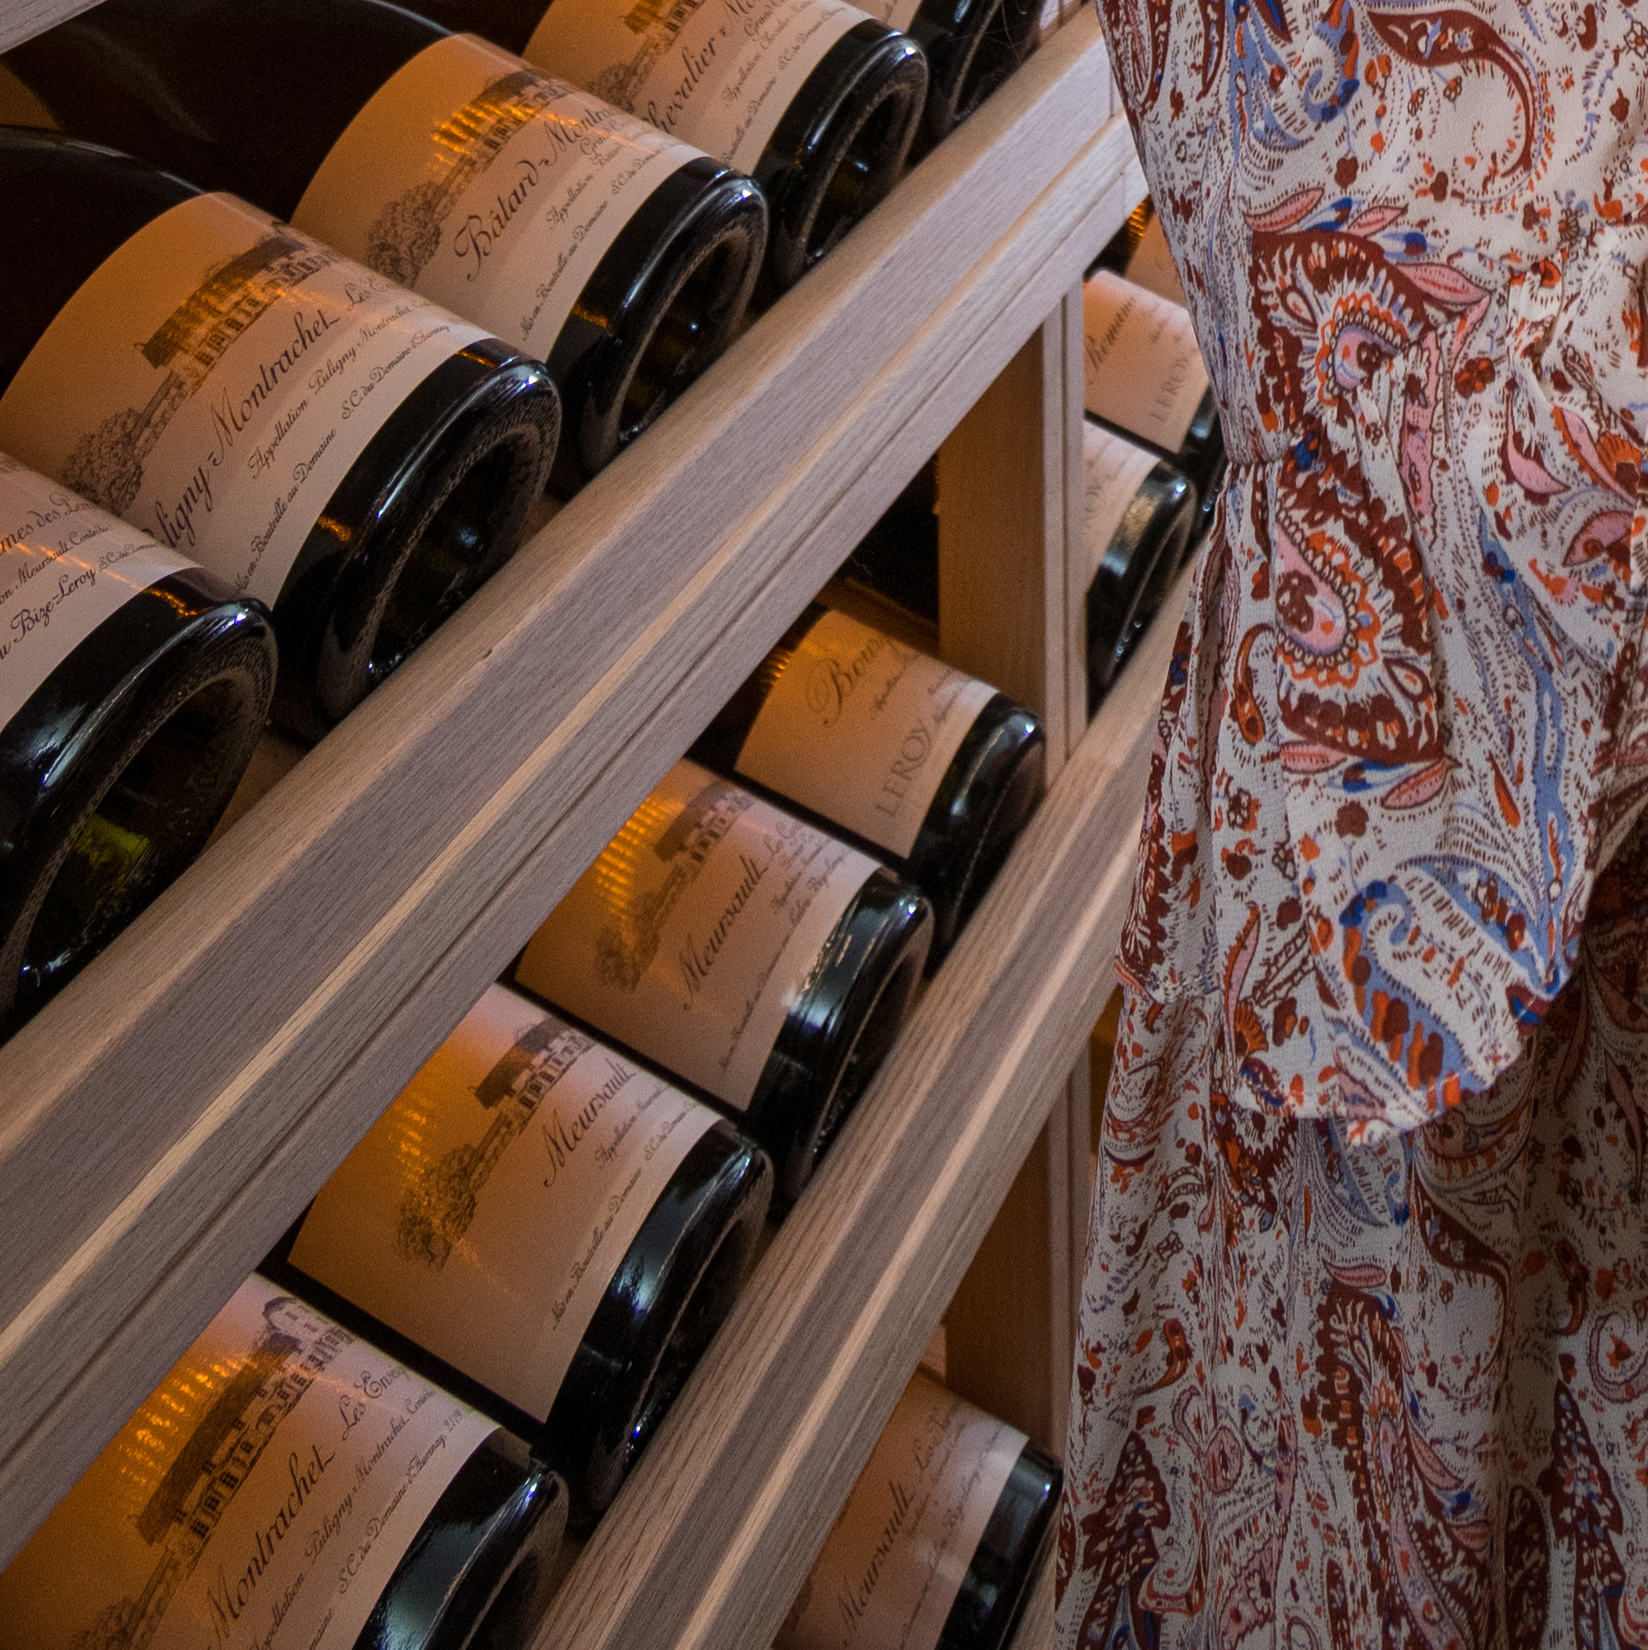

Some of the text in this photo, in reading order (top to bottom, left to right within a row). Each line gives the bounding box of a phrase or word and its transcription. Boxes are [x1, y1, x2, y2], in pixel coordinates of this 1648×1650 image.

[545, 173, 594, 231] Appellation
[535, 251, 569, 301] Bouteille
[571, 199, 609, 243] Domaine
[1151, 353, 1190, 423] LEROY
[248, 398, 309, 480] Appellation
[250, 495, 289, 561] Bouteille
[292, 427, 338, 485] Domaine
[10, 567, 96, 644] Bize-Leroy
[14, 541, 72, 590] Meursault
[875, 720, 932, 818] LEROY
[678, 854, 770, 1013] Meursault
[542, 1056, 637, 1189] Meursault
[594, 1112, 638, 1170] Appellation
[607, 1166, 643, 1216] Domaine
[204, 1442, 337, 1650] Montrachet
[338, 1393, 368, 1442] Les
[365, 1484, 408, 1541] Domaine
[837, 1479, 916, 1644] Meursault
